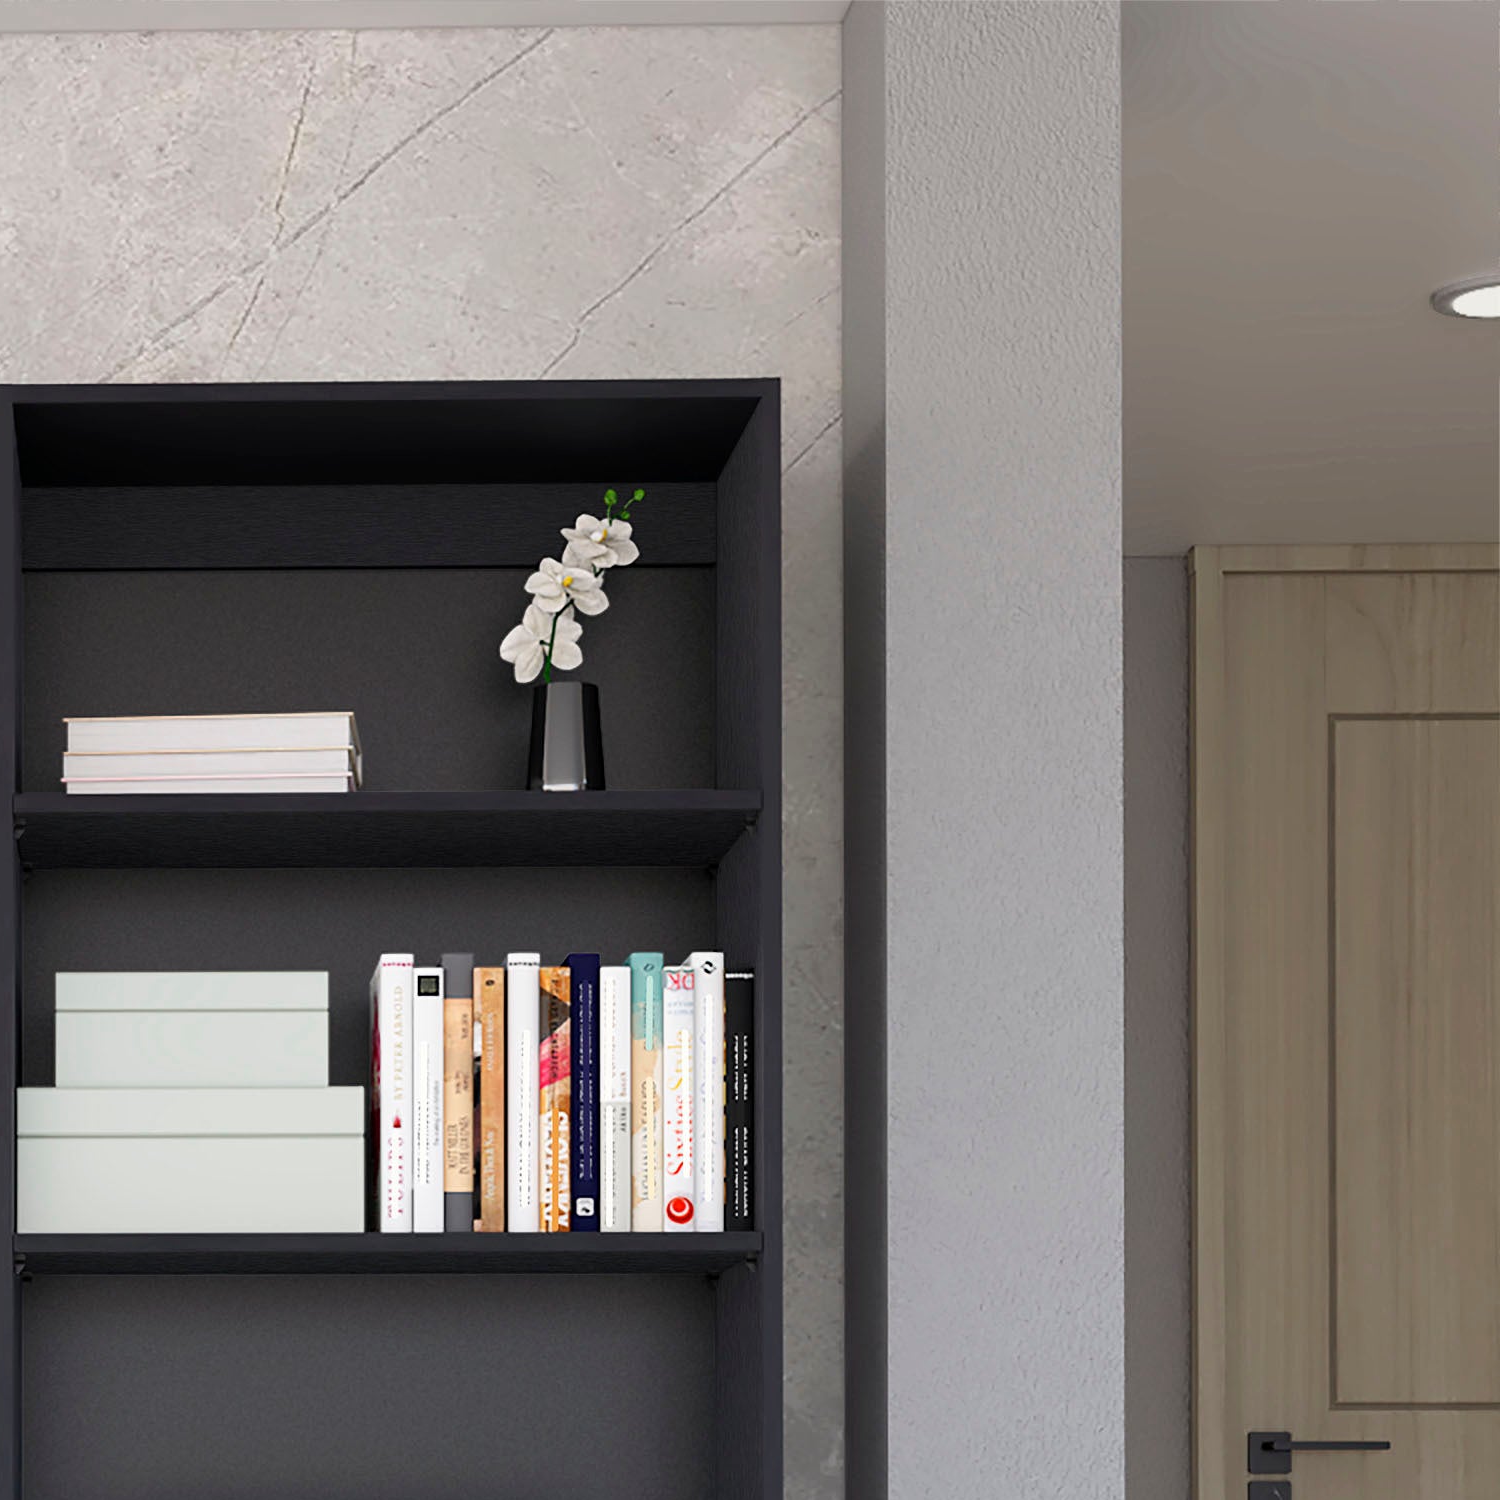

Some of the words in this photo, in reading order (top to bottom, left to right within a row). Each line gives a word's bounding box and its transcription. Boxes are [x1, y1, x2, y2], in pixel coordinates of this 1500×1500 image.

[393, 985, 403, 1037] ARNOLD
[393, 1042, 403, 1080] PETER
[393, 1086, 403, 1100] BY
